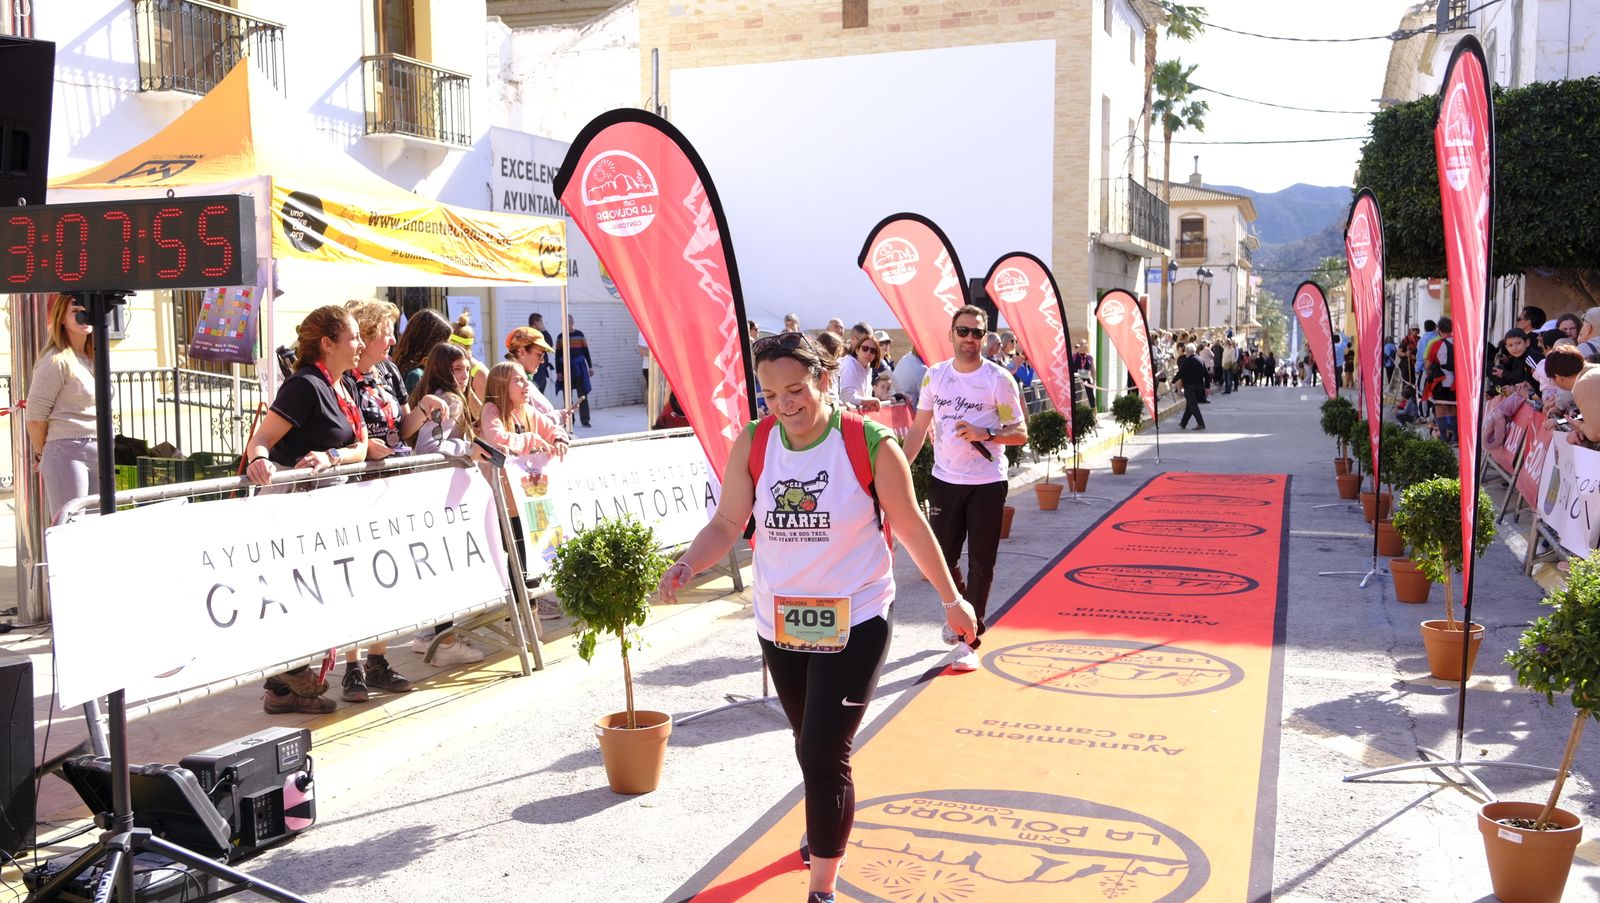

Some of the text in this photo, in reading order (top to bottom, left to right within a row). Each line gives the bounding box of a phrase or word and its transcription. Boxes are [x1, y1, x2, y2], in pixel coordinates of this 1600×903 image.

[290, 208, 305, 218] uno
[8, 205, 232, 283] 3:07:55
[954, 396, 984, 413] Yepes
[567, 463, 688, 492] AYUNTAMENTO
[570, 481, 717, 538] CANTORIA
[765, 512, 829, 528] ATARFE
[202, 503, 471, 570] AYUNTAMIENTO DE
[206, 530, 486, 628] CANTORIA
[785, 609, 835, 627] 409
[1057, 611, 1220, 626] Ayuntamiento
[1076, 606, 1169, 618] Cantoria
[982, 719, 1168, 743] de Cantoria
[954, 727, 1184, 756] Ayuntamiento
[912, 798, 1014, 817] Cantoria
[1018, 832, 1071, 845] Cxm
[1105, 828, 1161, 847] LA
